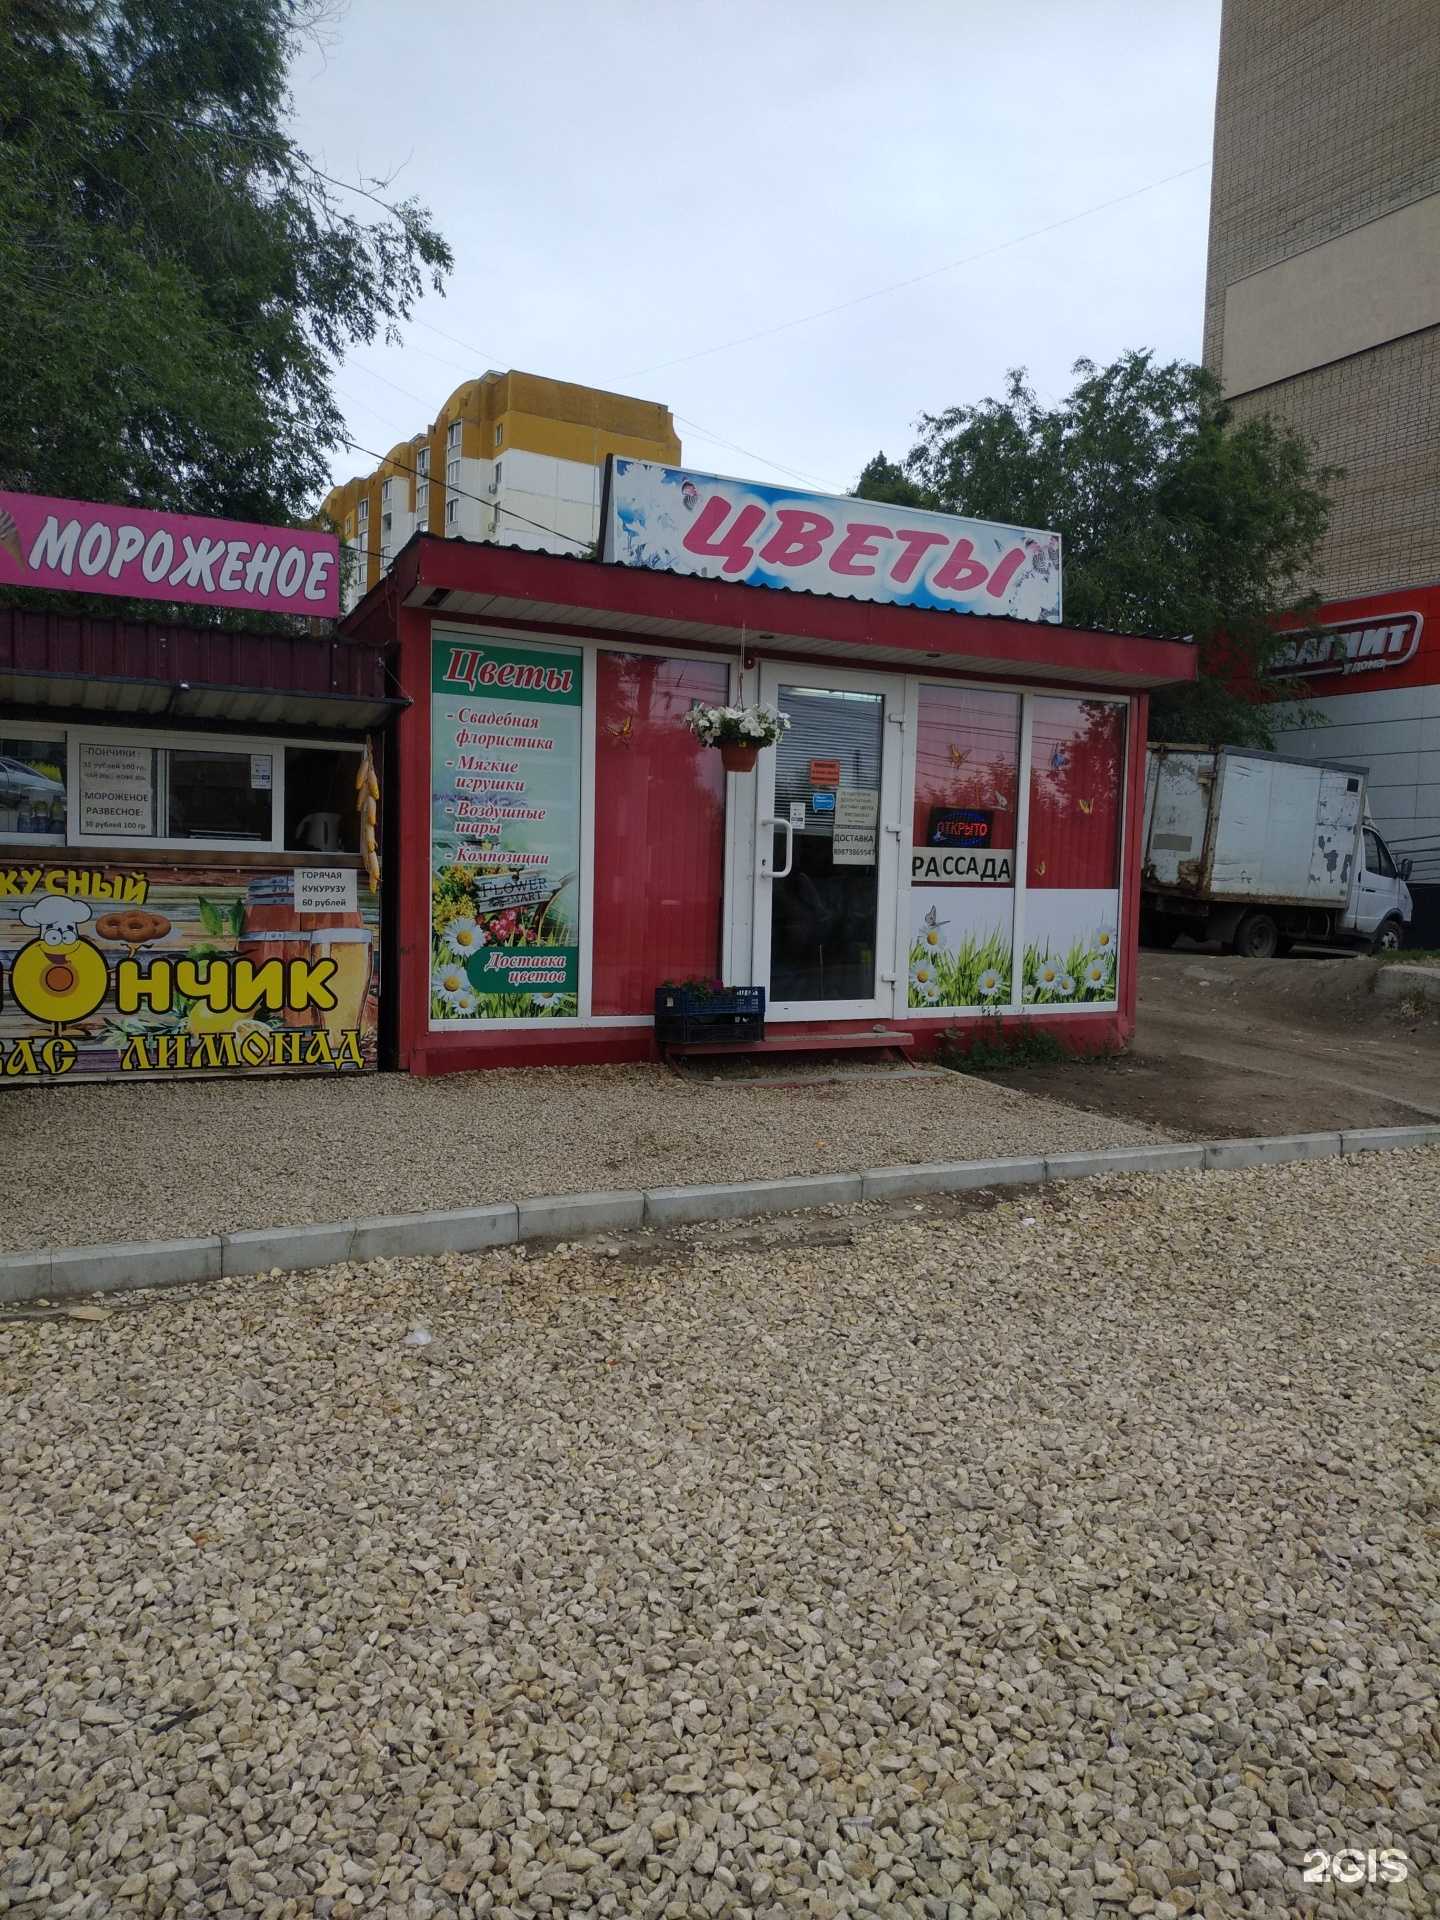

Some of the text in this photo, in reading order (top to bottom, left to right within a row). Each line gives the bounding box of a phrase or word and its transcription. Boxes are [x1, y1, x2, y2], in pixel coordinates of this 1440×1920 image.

[682, 495, 1026, 598] ЦВЕТЫ
[28, 515, 335, 602] МОРОЖЕНОЕ
[443, 647, 572, 692] Цветы
[457, 707, 539, 729] Свадебная
[455, 728, 554, 750] флористика
[457, 755, 519, 774] Мягкие
[455, 775, 526, 793] игрушки
[85, 791, 149, 802] МОРОЖЕНОЕ
[86, 807, 144, 817] РАЗВЕСНОЕ:
[457, 801, 546, 821] Воздушные
[455, 821, 503, 837] шары
[833, 834, 874, 842] ДОСТАВКА
[937, 821, 988, 837] ОТКРЫТО
[456, 849, 550, 866] Композиции
[302, 871, 342, 880] ГОРЯЧАЯ
[912, 856, 1011, 881] РАССАДА
[302, 885, 346, 893] КУКУРУЗУ
[481, 878, 548, 898] FLOWER
[302, 899, 346, 909] 60 рублей
[484, 952, 566, 972] Доставка
[508, 971, 566, 986] цветов
[0, 1029, 366, 1076] АС ЛИМОНАД
